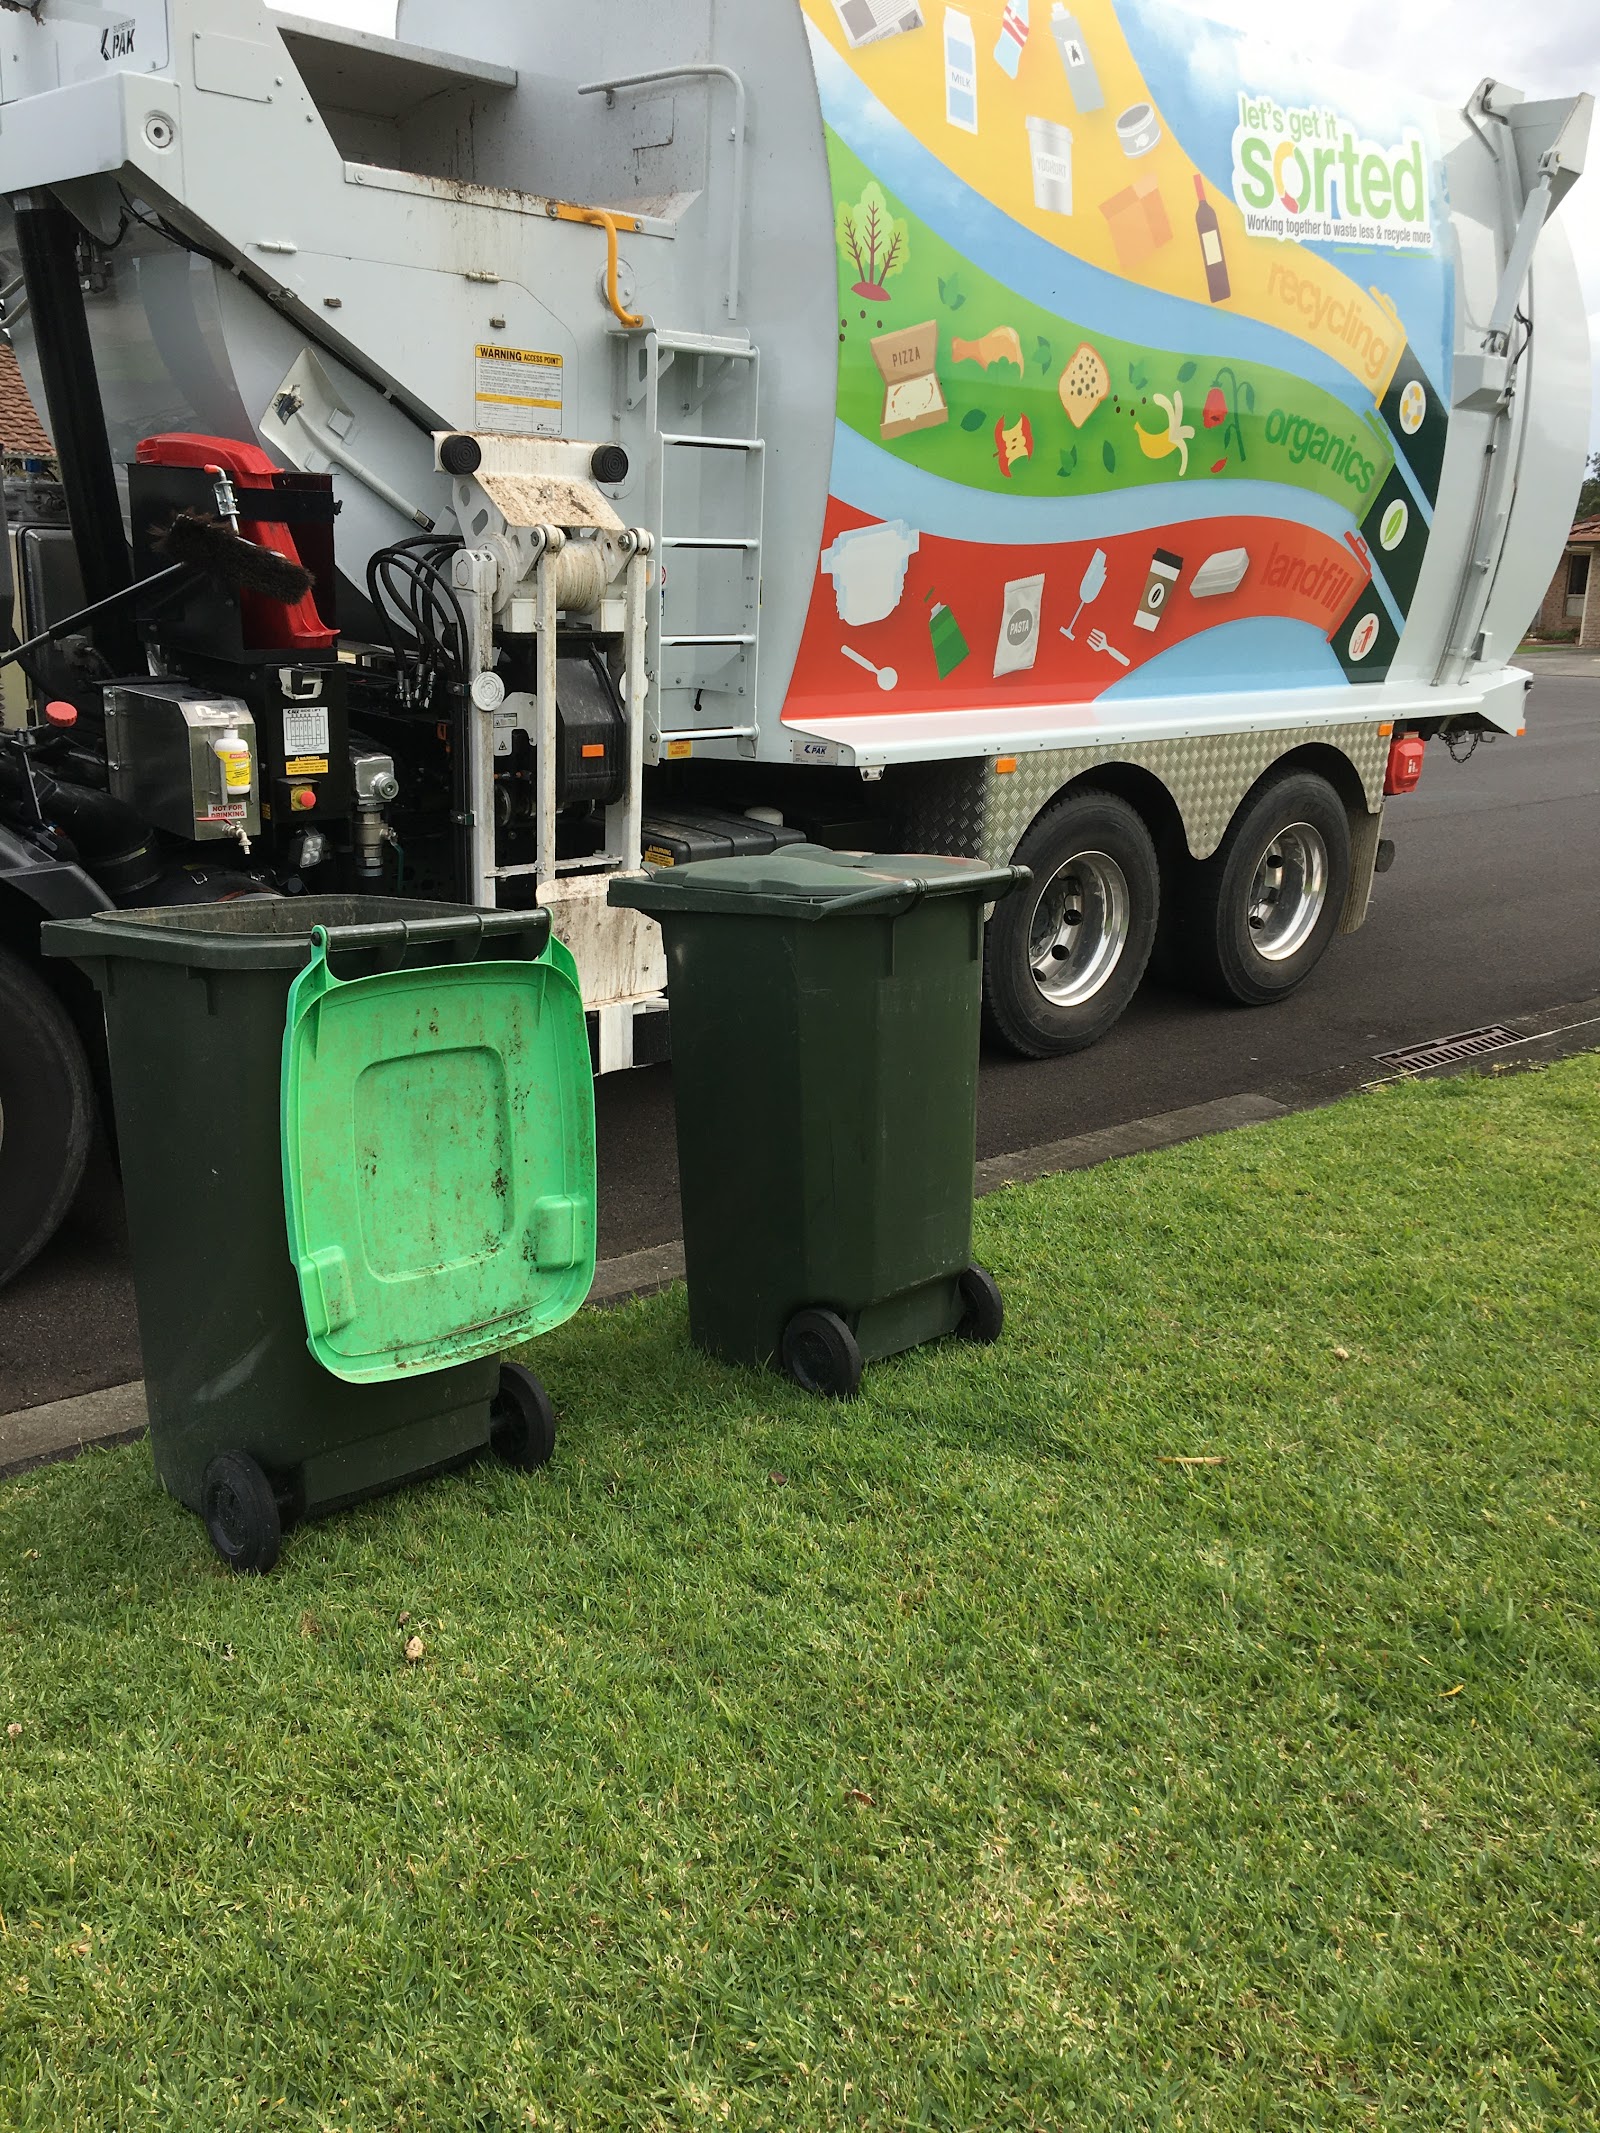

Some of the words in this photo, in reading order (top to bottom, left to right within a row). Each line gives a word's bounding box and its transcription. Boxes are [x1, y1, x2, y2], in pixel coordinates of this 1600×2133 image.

[112, 29, 136, 59] PAK
[951, 72, 972, 89] MILK
[1242, 97, 1284, 133] let's
[1289, 112, 1321, 142] get
[1324, 112, 1339, 141] it
[1036, 156, 1067, 179] YOGHURT
[1241, 133, 1425, 222] sorted
[1247, 214, 1283, 235] Working
[1286, 218, 1321, 236] together
[1323, 221, 1331, 235] to
[1333, 223, 1357, 237] waste
[1359, 224, 1374, 239] less
[1376, 225, 1383, 239] &
[1384, 228, 1411, 244] recycle
[1413, 231, 1431, 243] more
[1267, 262, 1389, 379] recycling
[523, 354, 544, 363] ACCESS
[892, 346, 920, 367] PIZZA
[1264, 408, 1376, 494] organics
[1259, 542, 1354, 613] landfill
[1010, 620, 1029, 635] PASTA
